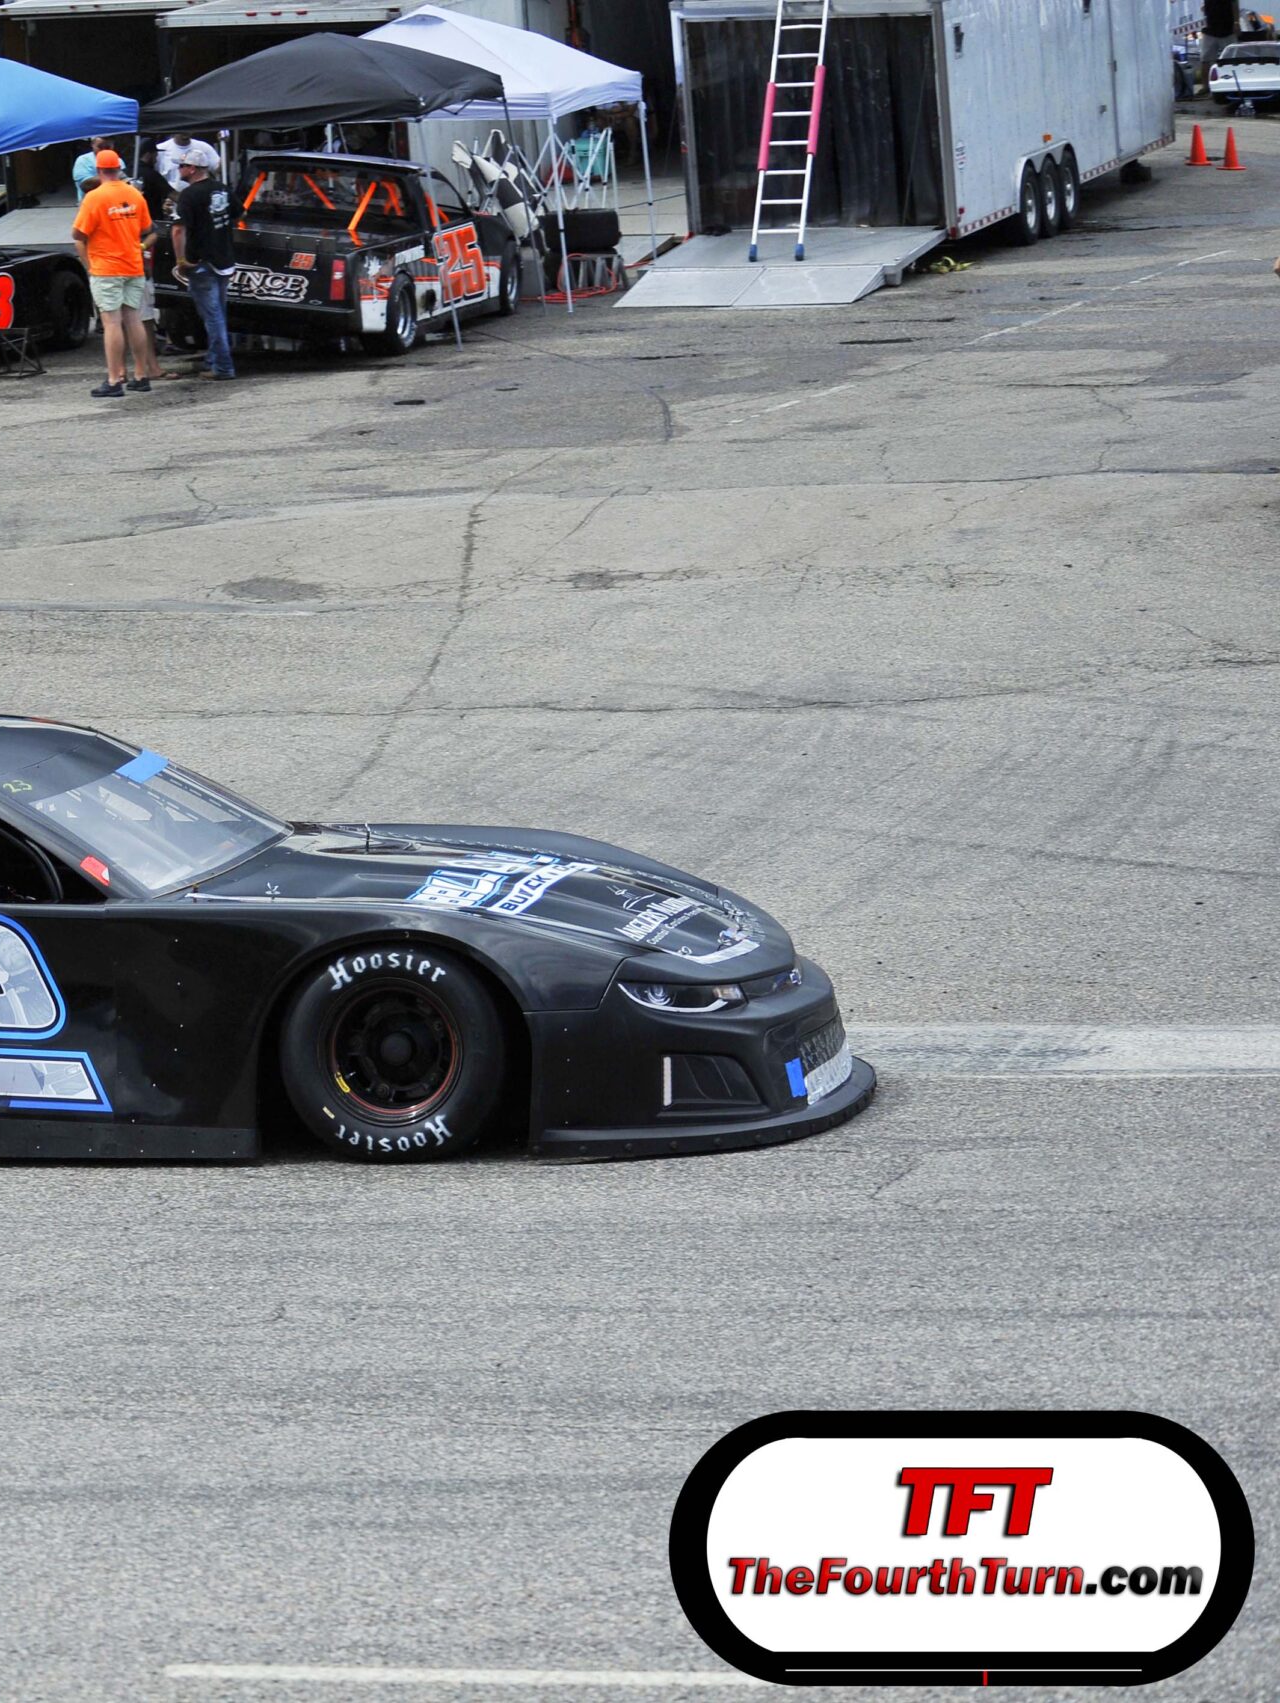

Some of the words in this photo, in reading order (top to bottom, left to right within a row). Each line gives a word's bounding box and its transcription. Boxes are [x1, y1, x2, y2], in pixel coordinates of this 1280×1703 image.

[433, 223, 487, 304] 25
[327, 949, 447, 991] Hoosier
[336, 1114, 452, 1154] Hoosier
